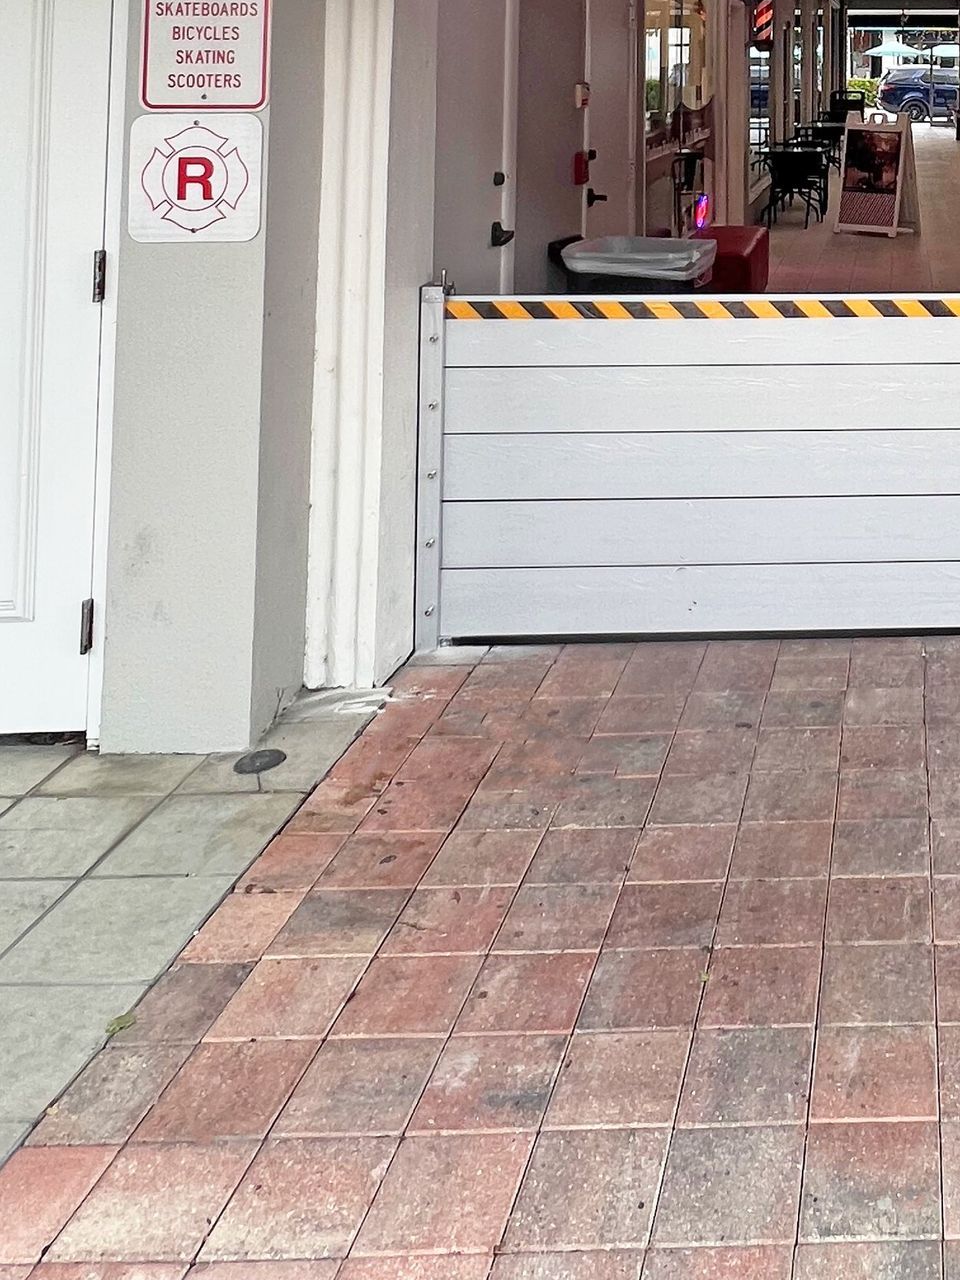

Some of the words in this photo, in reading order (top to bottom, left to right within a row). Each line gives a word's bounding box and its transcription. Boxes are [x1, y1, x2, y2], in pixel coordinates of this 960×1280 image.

[155, 2, 259, 17] SKATEBOARDS
[172, 26, 240, 41] BICYCLES
[175, 50, 236, 65] SKATING
[167, 73, 242, 89] SCOOTERS
[176, 156, 215, 201] R
